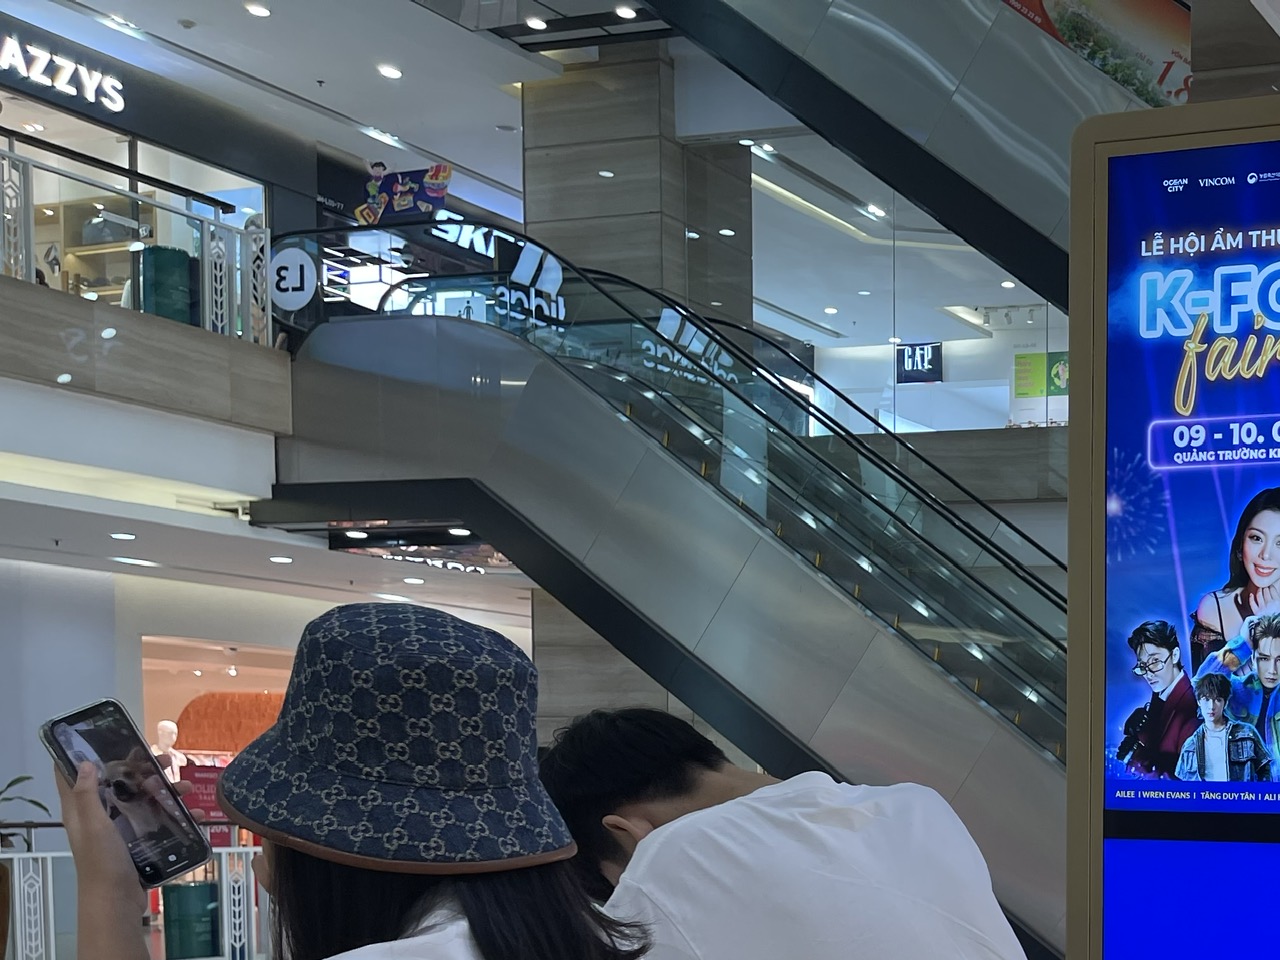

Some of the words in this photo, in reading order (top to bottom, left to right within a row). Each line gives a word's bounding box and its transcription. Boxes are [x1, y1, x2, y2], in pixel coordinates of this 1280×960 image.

[1199, 176, 1235, 187] VINCOM
[1141, 232, 1164, 256] LỄ
[1170, 232, 1205, 257] HỘI
[1210, 228, 1243, 251] ẨM
[904, 345, 932, 371] GAP
[1173, 424, 1206, 448] 09
[1229, 422, 1265, 445] 10.
[1173, 449, 1216, 464] QUẢNG
[1217, 447, 1267, 461] TRƯỜNG
[1115, 790, 1135, 798] AILEE
[1142, 791, 1164, 799] WREN
[1166, 791, 1191, 799] EVANS
[1222, 792, 1239, 800] DUY
[1264, 793, 1277, 801] ALI
